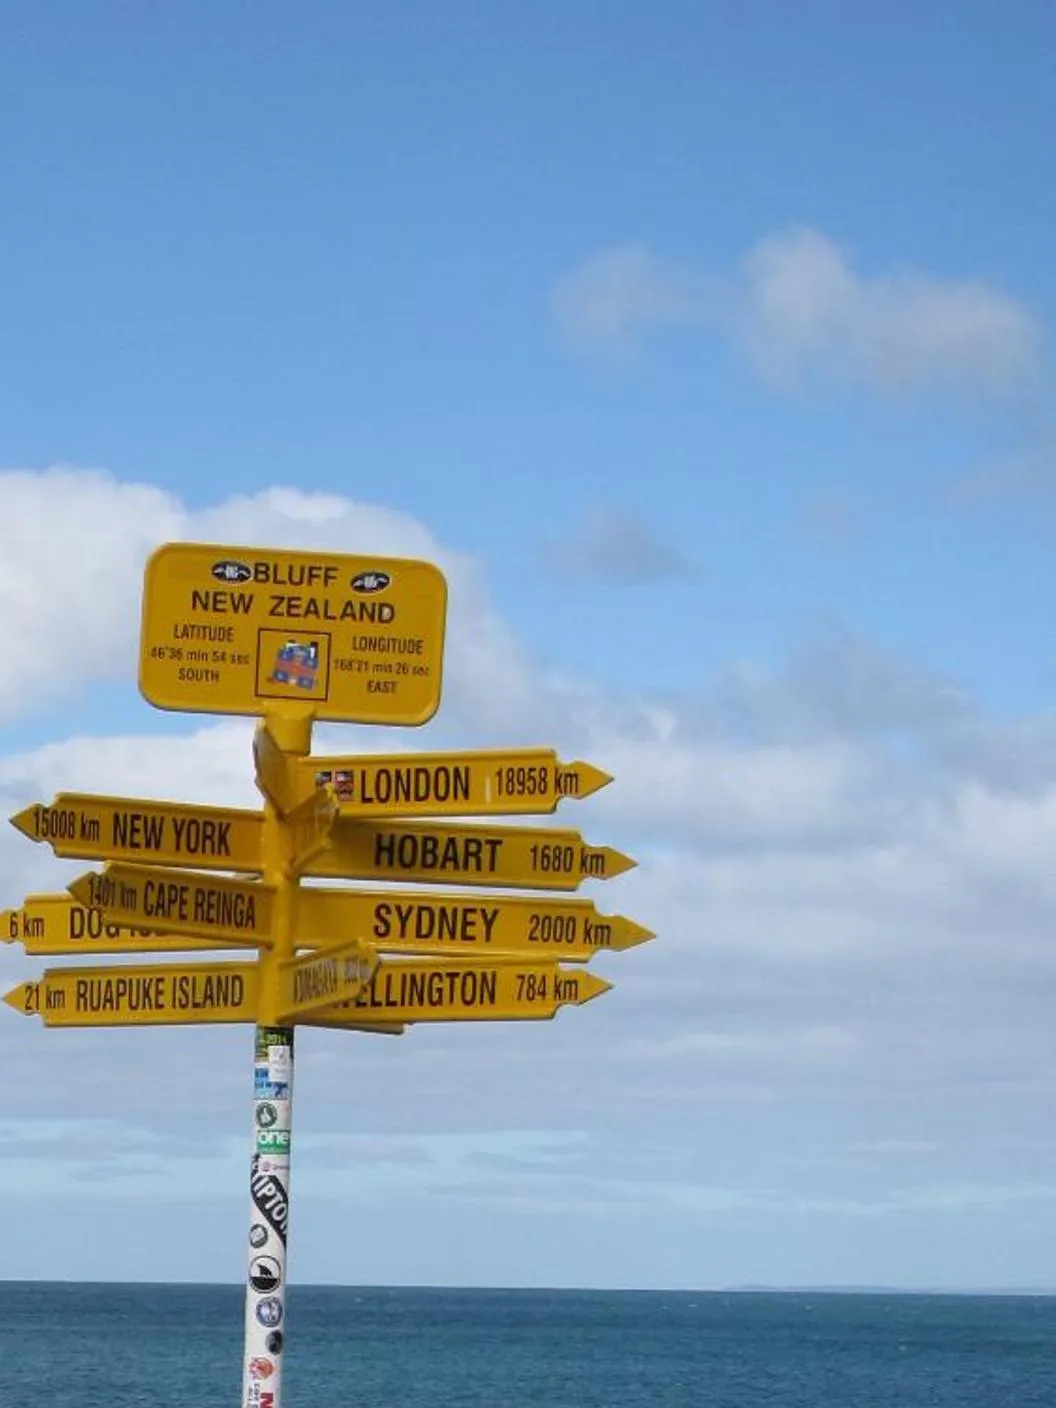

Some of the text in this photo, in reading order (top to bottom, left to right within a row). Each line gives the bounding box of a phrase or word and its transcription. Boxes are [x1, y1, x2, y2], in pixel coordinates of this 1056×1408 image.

[253, 562, 339, 588] BLUFF
[191, 590, 396, 625] NEW ZEALAND
[173, 624, 235, 642] LATITUDE
[352, 635, 424, 655] LONGITUDE
[186, 650, 209, 662] min
[395, 662, 409, 675] 26
[178, 667, 220, 682] SOUTH
[367, 680, 398, 694] EAST
[360, 766, 579, 804] LONDON 18958 km
[32, 807, 232, 857] 15008 km NEW YORK
[373, 833, 606, 874] HOBART 1680 km
[143, 880, 188, 921] CAPE
[194, 886, 256, 930] REINGA
[9, 911, 19, 939] 6
[23, 912, 45, 938] km
[372, 903, 612, 946] SYDNEY 2000 km
[25, 974, 244, 1012] 21 km RUAPUKE ISLAND
[516, 974, 548, 1002] 784
[553, 974, 579, 1002] km
